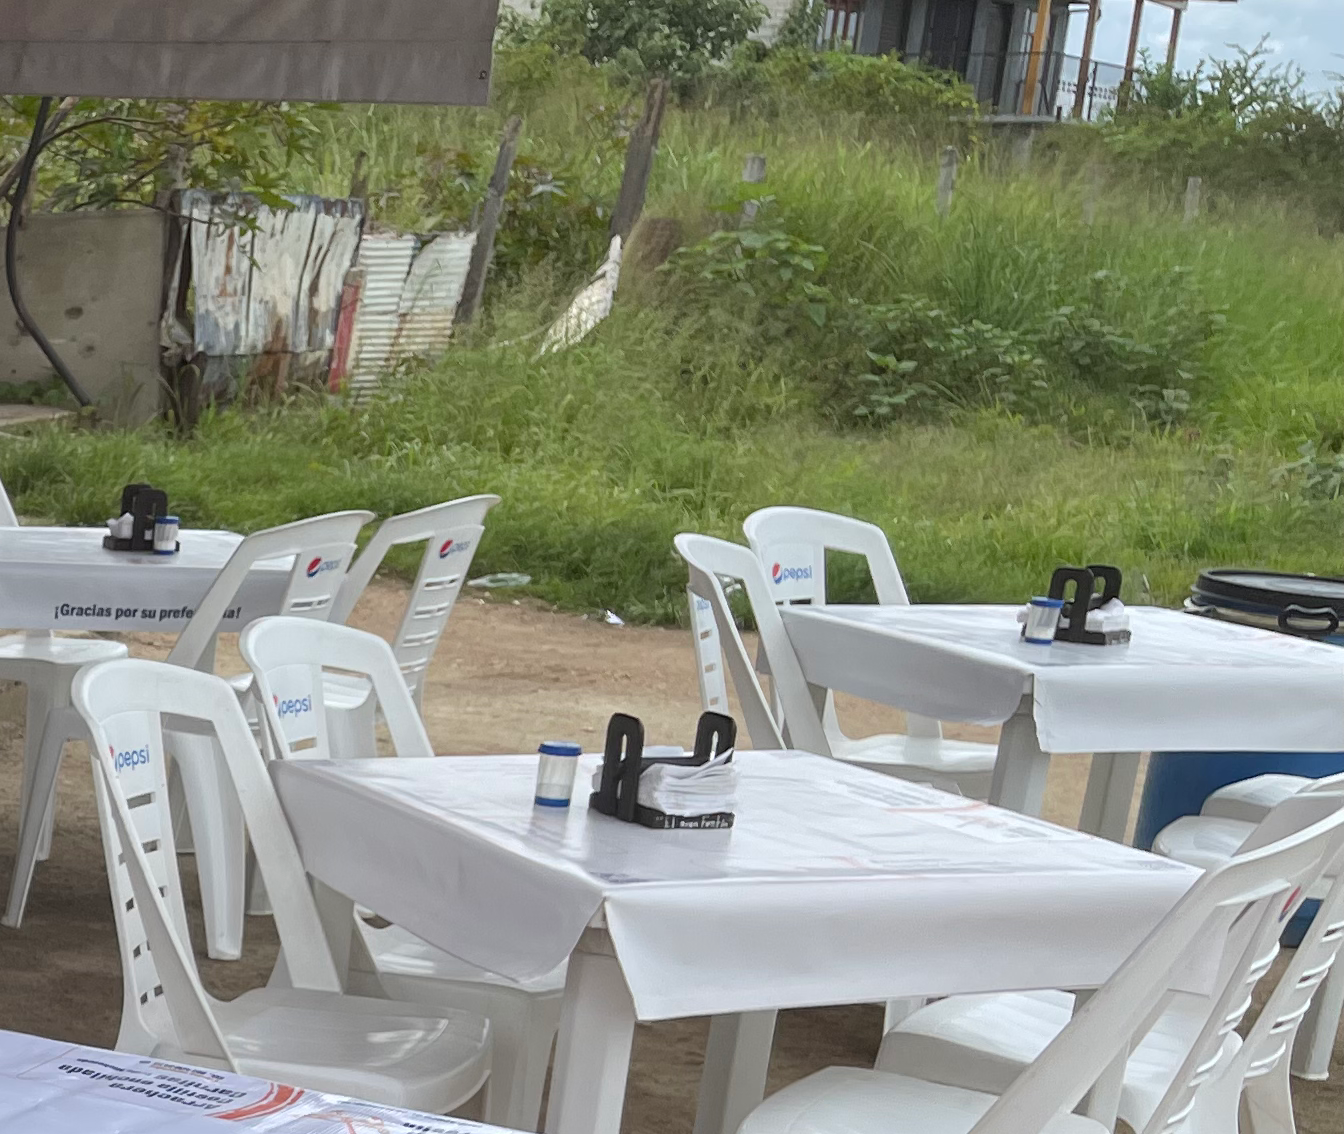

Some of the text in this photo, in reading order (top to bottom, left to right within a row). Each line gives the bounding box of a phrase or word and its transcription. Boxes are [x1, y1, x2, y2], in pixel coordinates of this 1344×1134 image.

[54, 603, 112, 619] ¡Gracias
[115, 607, 138, 620] por
[140, 608, 156, 618] su
[279, 694, 312, 718] pepsi
[117, 745, 150, 772] pepsi
